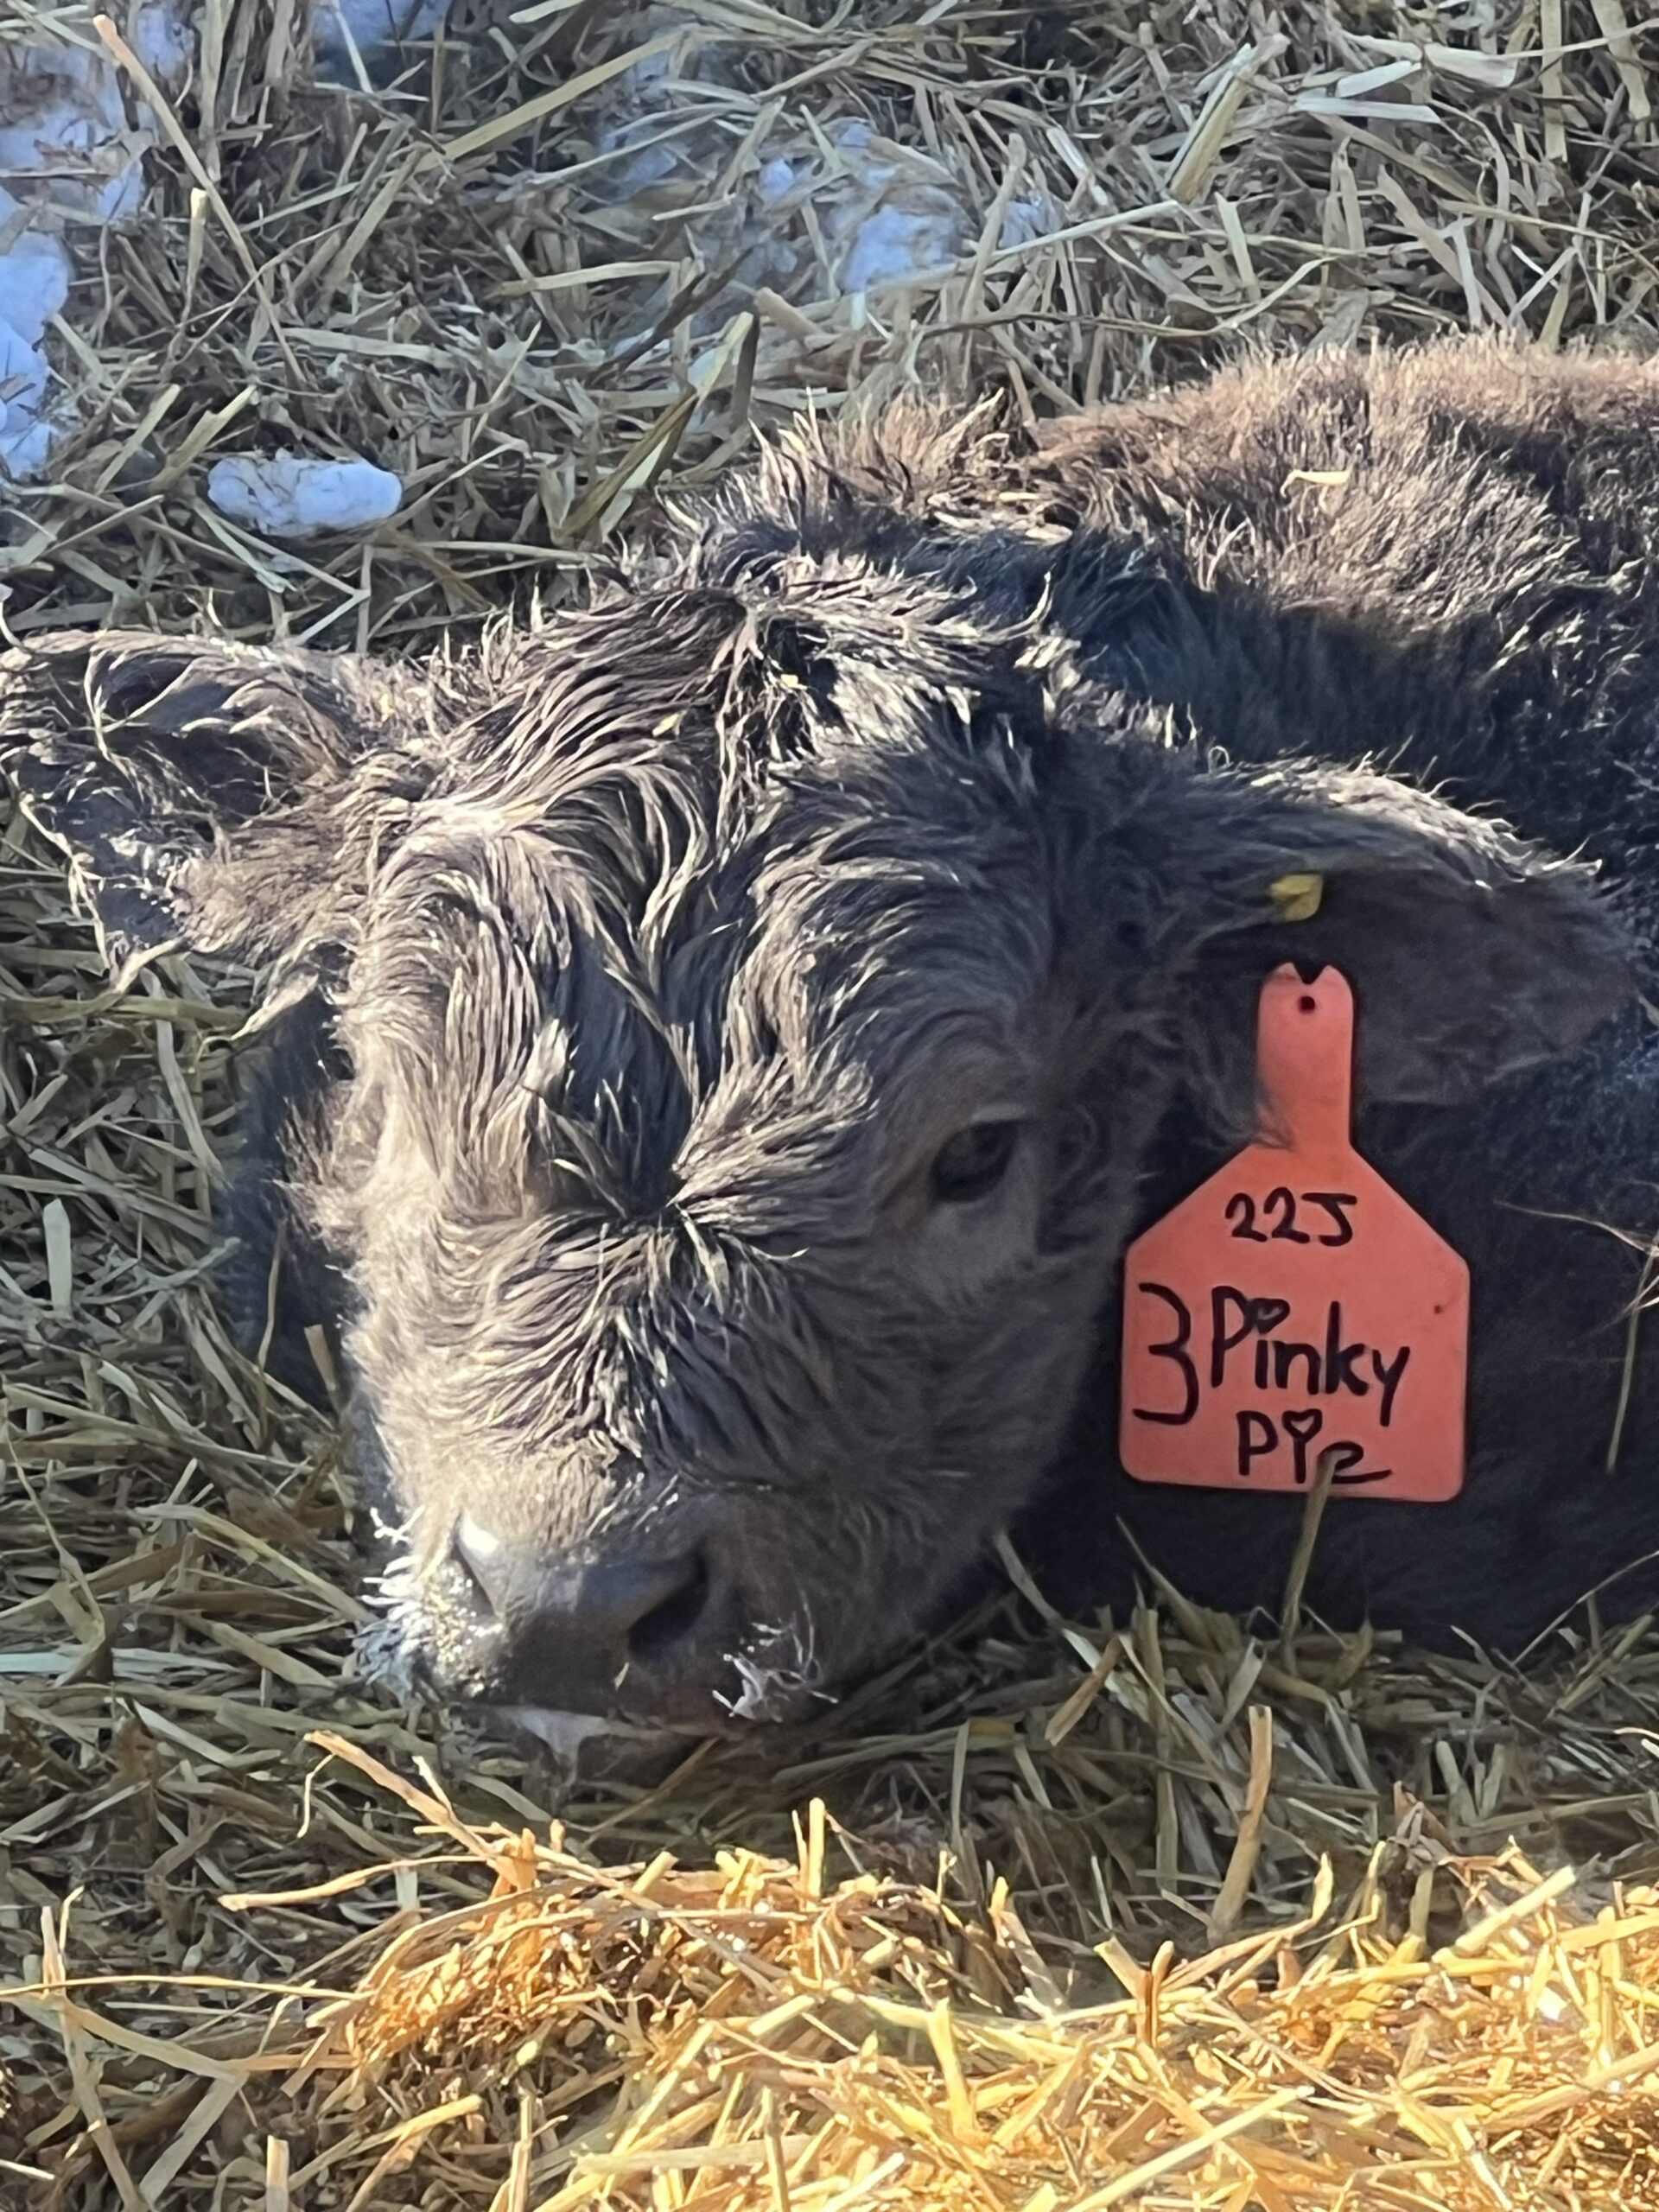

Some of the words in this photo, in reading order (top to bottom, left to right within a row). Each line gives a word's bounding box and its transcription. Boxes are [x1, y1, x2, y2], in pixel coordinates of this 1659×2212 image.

[1225, 1187, 1357, 1246] 22J
[1133, 1282, 1199, 1425] 3
[1211, 1286, 1411, 1427] Pinky
